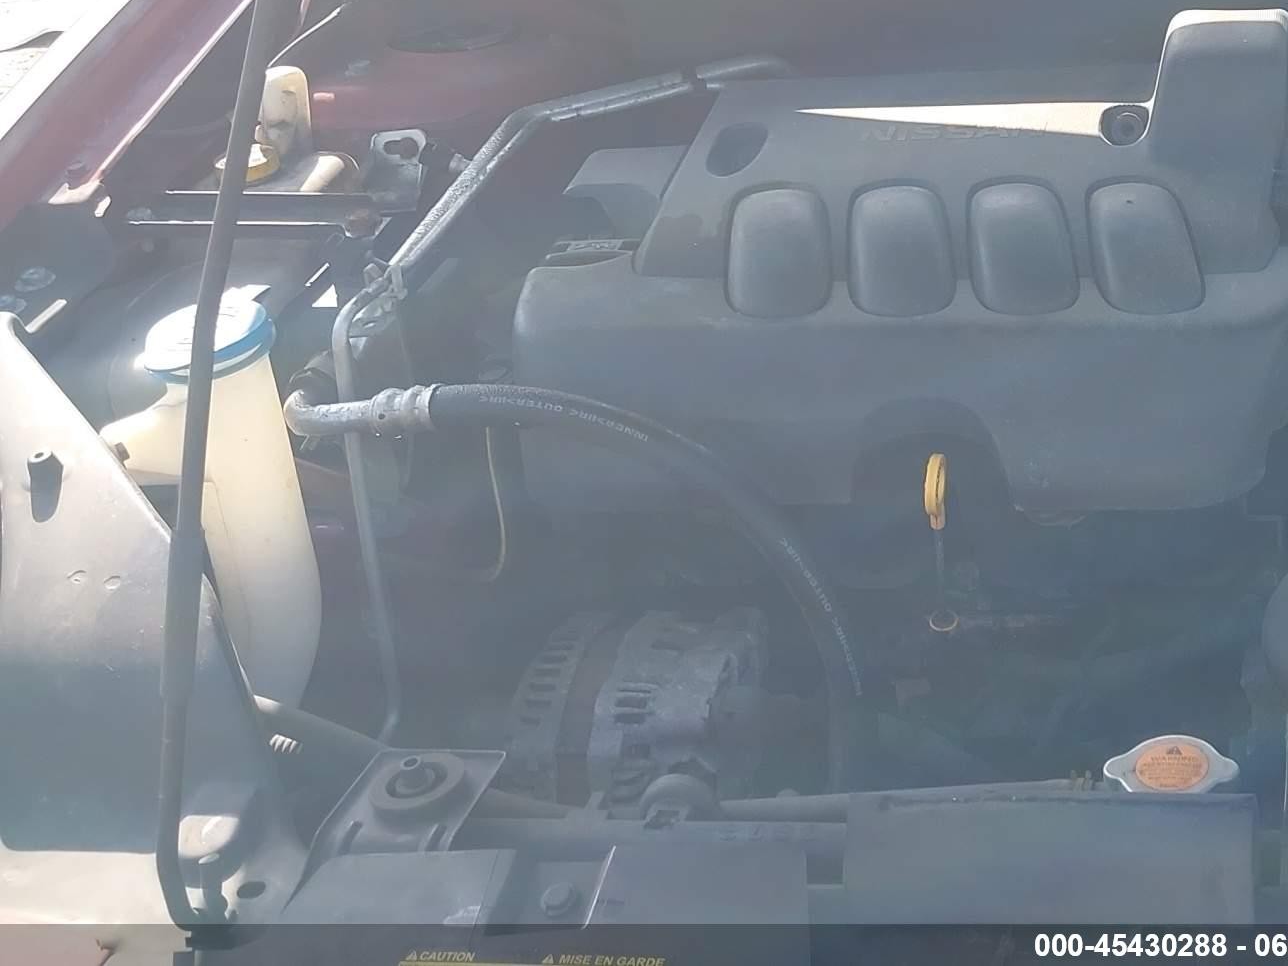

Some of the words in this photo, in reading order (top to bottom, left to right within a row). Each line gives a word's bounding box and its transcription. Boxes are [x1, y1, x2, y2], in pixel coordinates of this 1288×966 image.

[419, 950, 476, 963] CAUTION
[558, 954, 592, 966] MISE
[594, 955, 614, 966] EN
[616, 955, 666, 966] GARDE
